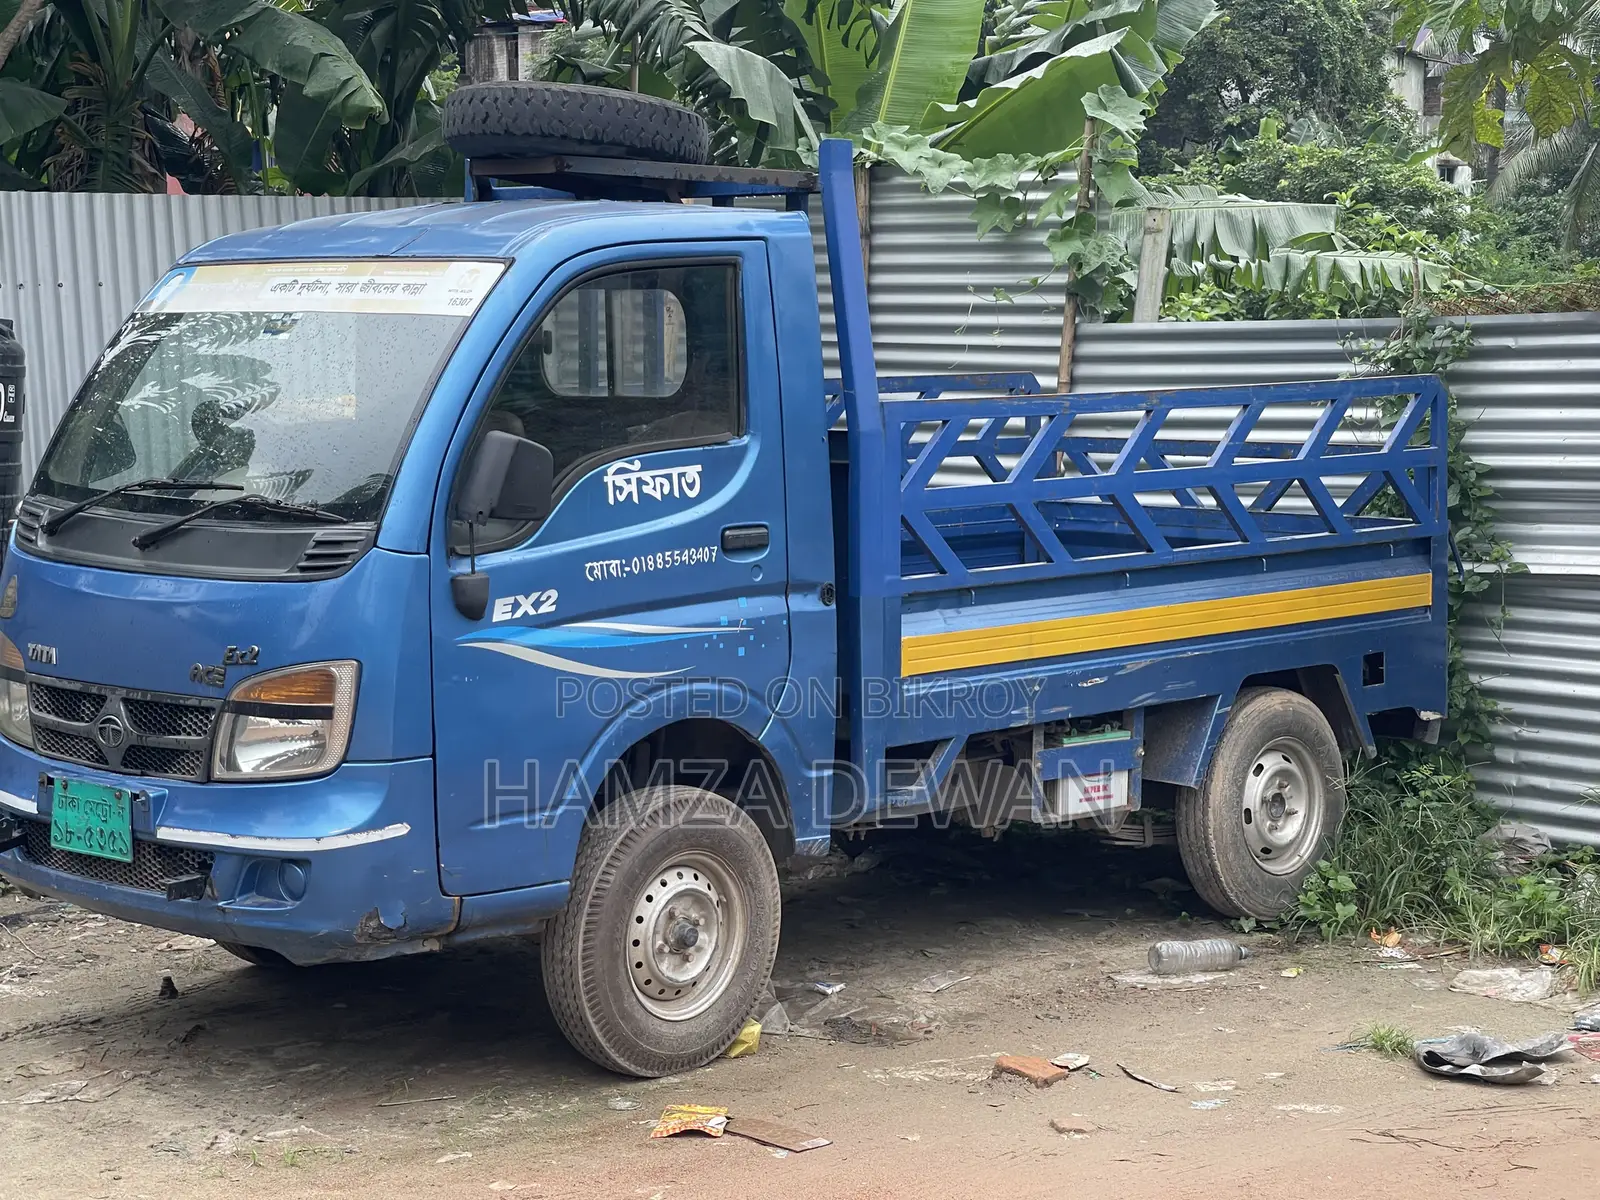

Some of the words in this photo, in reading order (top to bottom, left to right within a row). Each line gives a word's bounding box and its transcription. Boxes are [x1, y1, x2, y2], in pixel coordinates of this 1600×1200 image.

[270, 278, 299, 294] একটি
[335, 281, 359, 294] সারা
[359, 278, 401, 295] জীবনের
[401, 282, 428, 296] কান্না
[447, 297, 474, 307] 16307
[603, 459, 703, 506] সিফাত
[491, 588, 559, 623] EX2
[27, 642, 57, 665] TATA
[190, 662, 226, 688] ACE
[58, 793, 81, 814] ঢাকা
